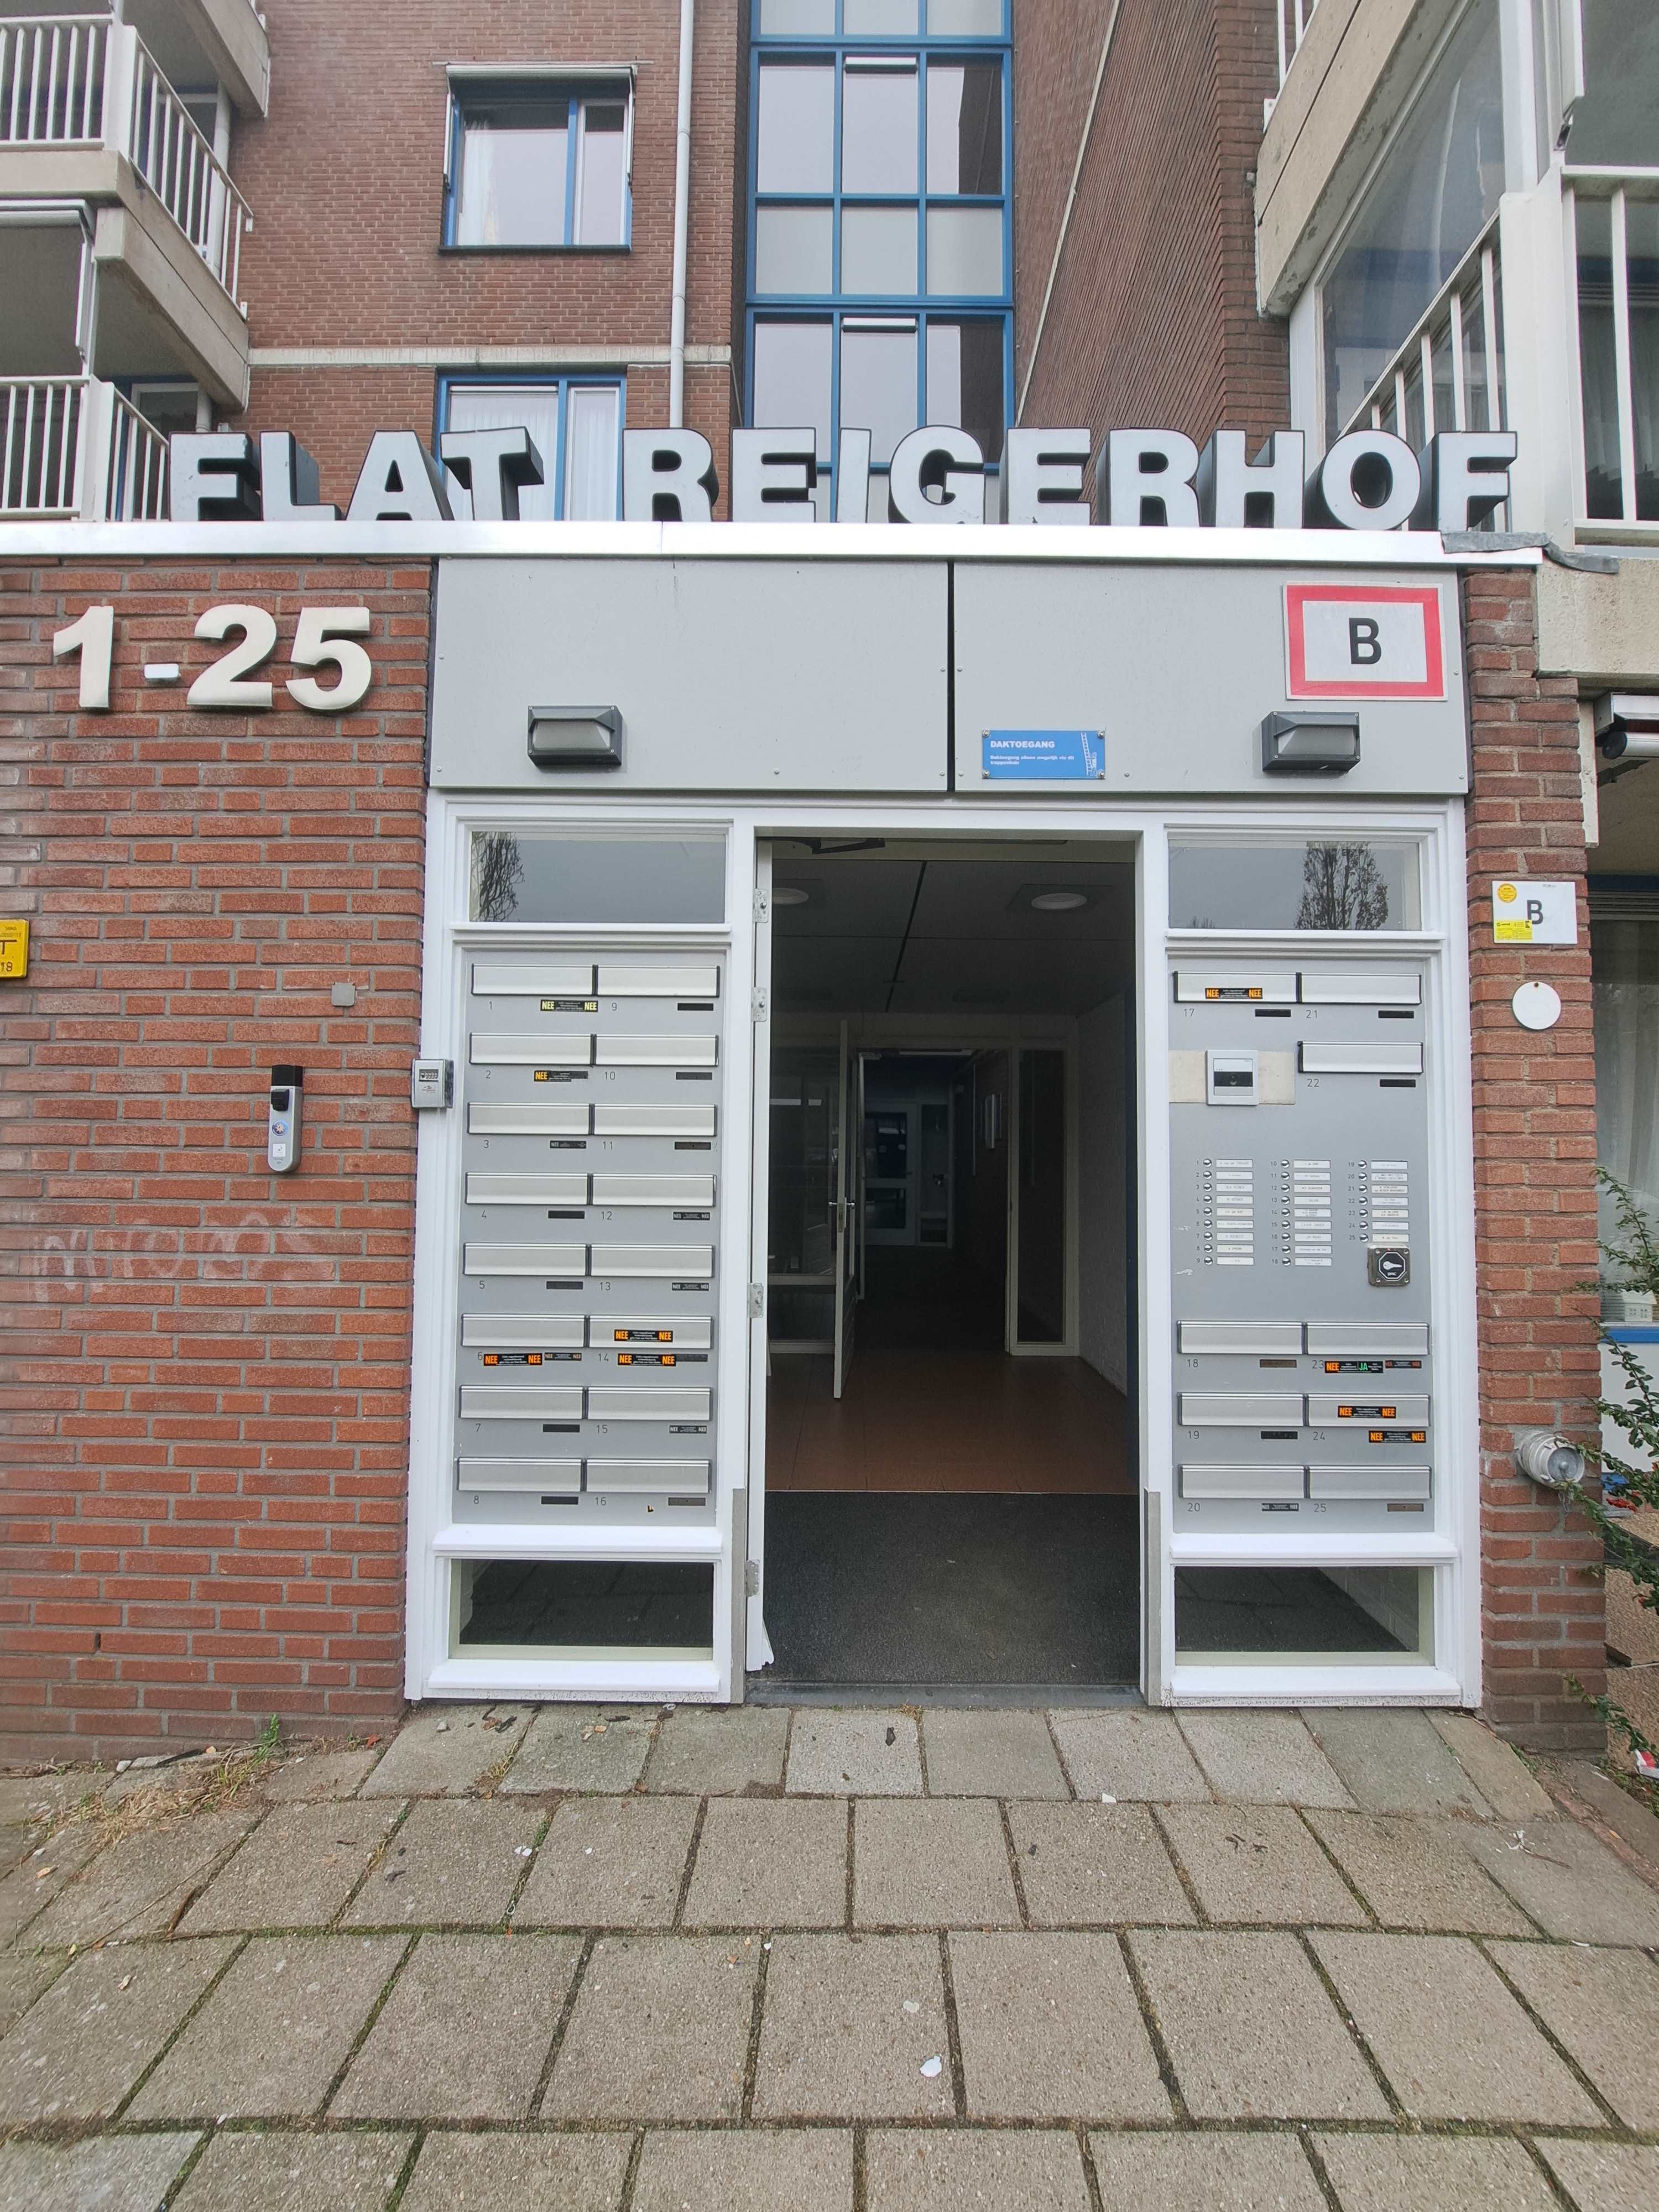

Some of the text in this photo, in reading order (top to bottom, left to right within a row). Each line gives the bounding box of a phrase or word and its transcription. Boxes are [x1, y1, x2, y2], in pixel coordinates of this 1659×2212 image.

[170, 425, 1518, 532] FLAT REIGERHOF
[1348, 617, 1381, 665] B
[53, 604, 372, 710] 1-25
[1527, 900, 1543, 925] B
[542, 1001, 554, 1009] NEE
[612, 1003, 617, 1011] 9
[1306, 1010, 1317, 1018] 21
[486, 1070, 491, 1078] 2
[605, 1071, 615, 1079] 10
[484, 1140, 489, 1148] 3
[602, 1211, 612, 1220] 12
[479, 1281, 484, 1289] 5
[600, 1282, 611, 1291] 13
[615, 1331, 628, 1339] NEE
[659, 1332, 671, 1340] NEE
[485, 1355, 498, 1364] NEE
[528, 1355, 541, 1363] NEE
[598, 1354, 609, 1362] 14
[619, 1355, 632, 1363] NEE
[662, 1356, 674, 1364] NEE
[1188, 1359, 1198, 1368] 18
[1312, 1360, 1324, 1369] 23
[1326, 1362, 1339, 1371] NEE
[1359, 1363, 1368, 1371] JA
[1339, 1407, 1352, 1416] NEE
[1383, 1408, 1395, 1416] NEE
[476, 1423, 481, 1432] 7
[597, 1425, 607, 1433] 15
[1188, 1431, 1199, 1439] 19
[1313, 1431, 1324, 1440] 24
[1370, 1432, 1383, 1441] NEE
[474, 1495, 479, 1504] 8
[596, 1497, 606, 1505] 16
[1188, 1503, 1199, 1511] 20
[1314, 1503, 1326, 1512] 25
